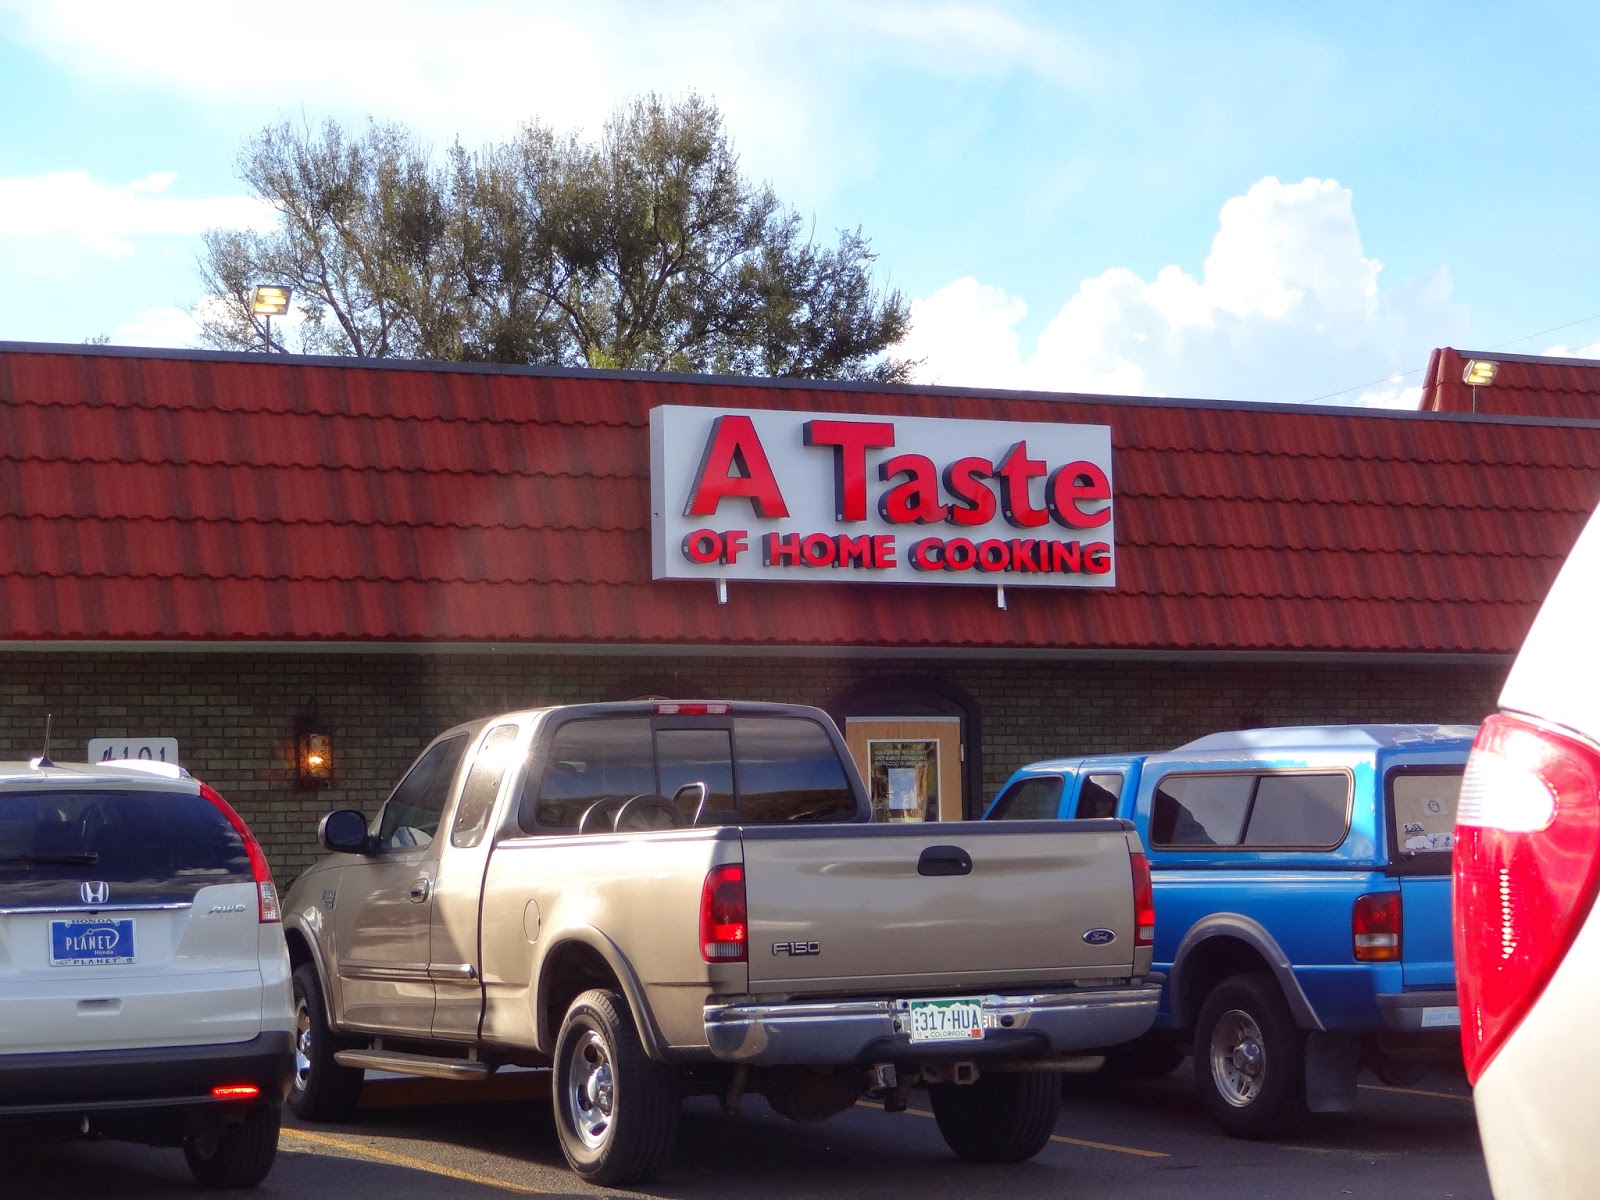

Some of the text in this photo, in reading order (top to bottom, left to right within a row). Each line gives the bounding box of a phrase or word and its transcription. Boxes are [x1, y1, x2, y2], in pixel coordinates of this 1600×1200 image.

[683, 415, 1112, 530] A Taste
[682, 528, 1112, 575] OF HOME COOKING
[207, 904, 246, 914] AWD
[73, 957, 118, 965] PLANET
[930, 1030, 966, 1038] COLORADO
